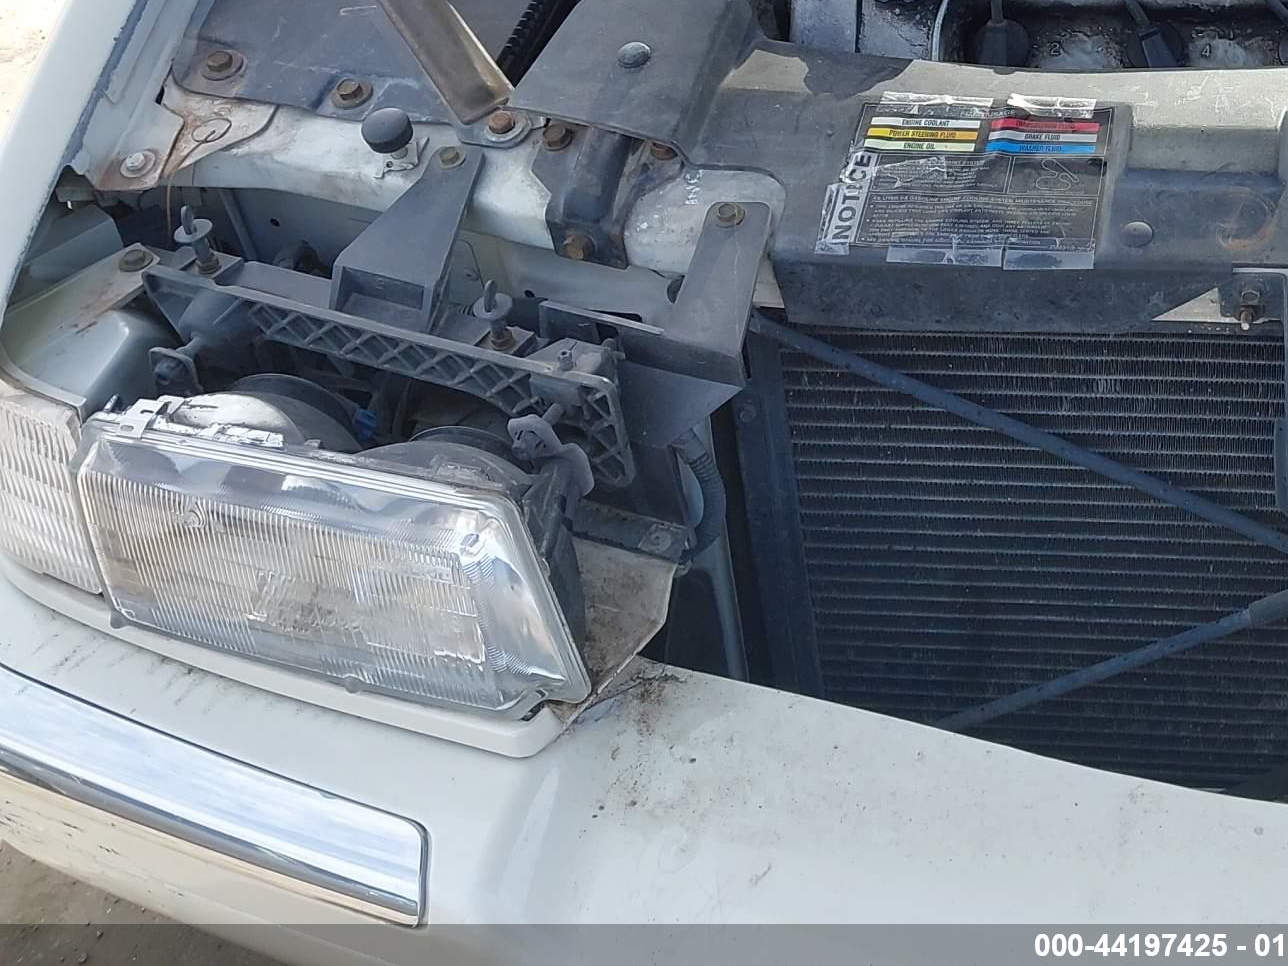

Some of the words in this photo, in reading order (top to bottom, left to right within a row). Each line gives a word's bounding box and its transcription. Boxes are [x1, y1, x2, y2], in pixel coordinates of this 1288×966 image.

[923, 119, 950, 127] COOLANT
[889, 129, 909, 137] POWER
[911, 130, 938, 138] STEERING
[939, 131, 957, 139] FLUID
[831, 154, 872, 240] NOTICE
